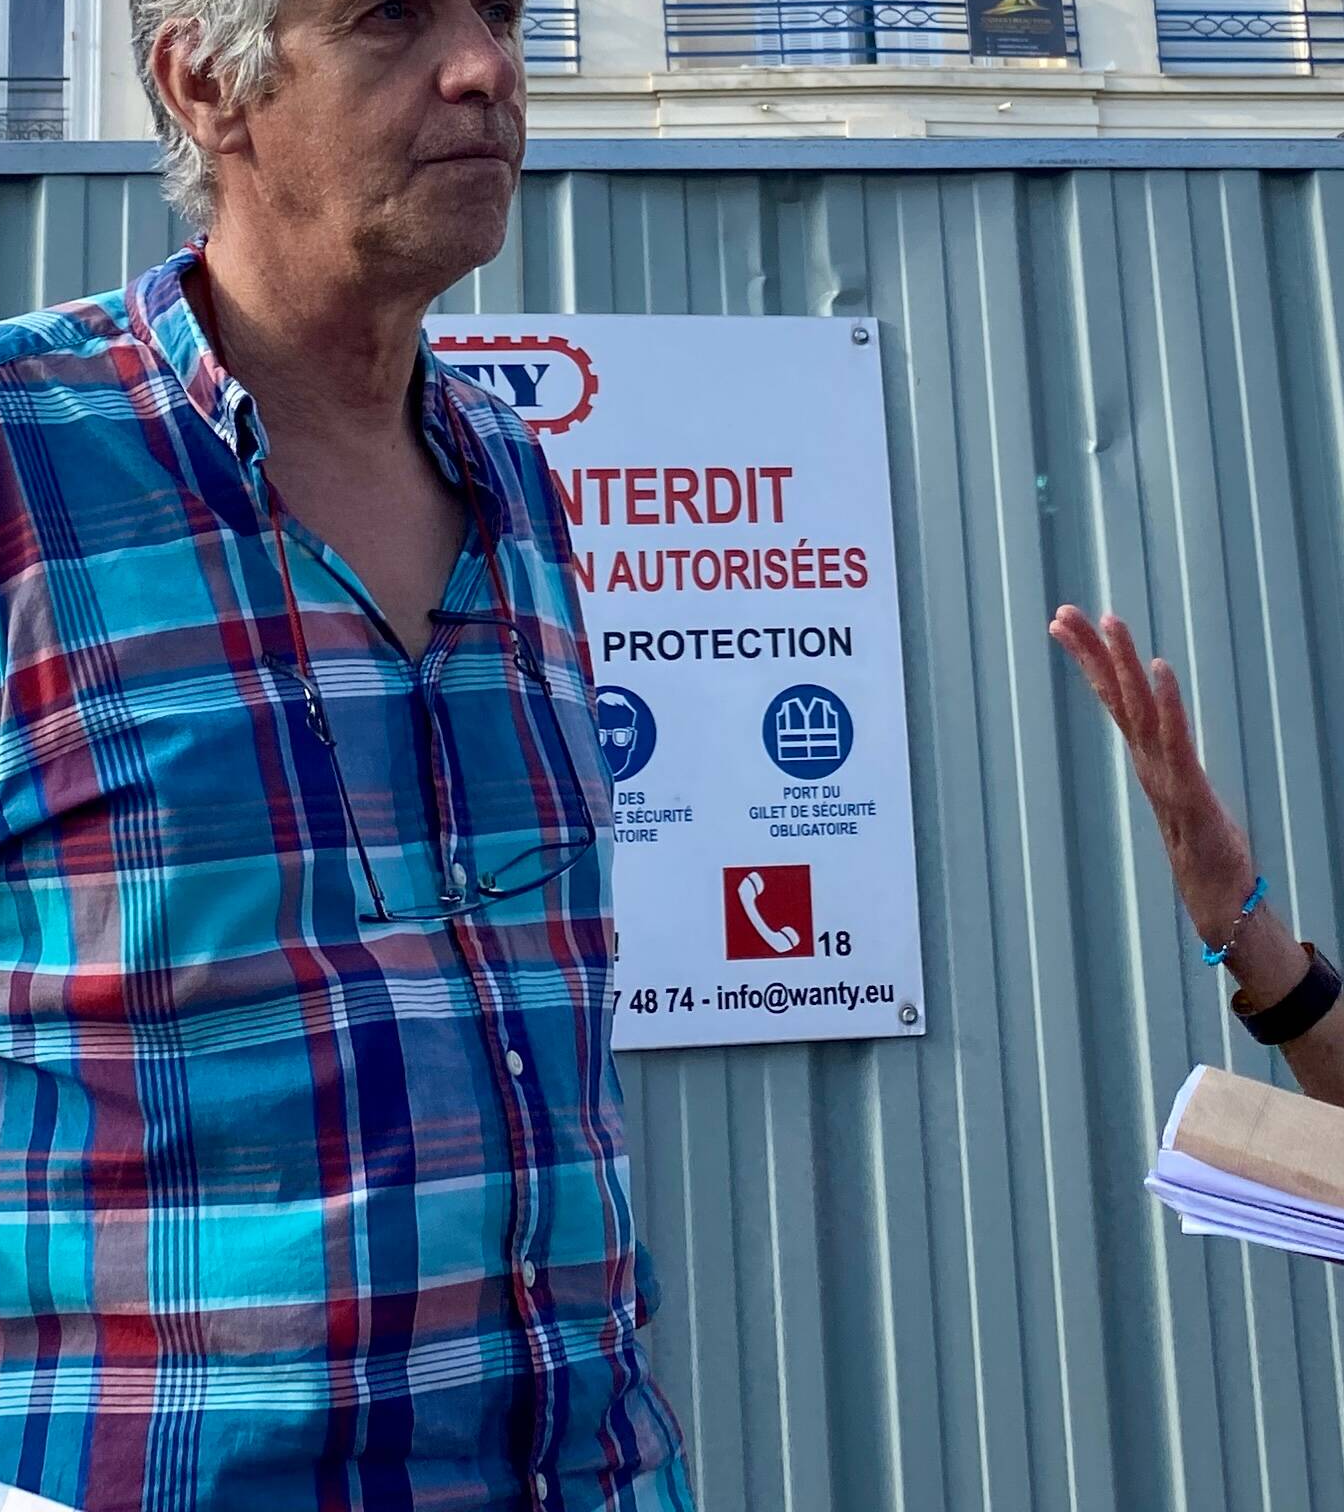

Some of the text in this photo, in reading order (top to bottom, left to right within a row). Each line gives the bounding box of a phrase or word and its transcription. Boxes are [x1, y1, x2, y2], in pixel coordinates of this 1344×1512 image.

[607, 538, 868, 593] AUTORISÉES
[603, 626, 852, 662] PROTECTION
[618, 791, 645, 806] DES
[783, 786, 840, 800] PORT DU
[626, 805, 693, 824] SÉCURITÉ
[749, 801, 876, 820] GILET DE SÉCURITÉ
[769, 822, 858, 838] OBLIGATOIRE
[818, 931, 851, 957] 18
[629, 988, 658, 1014] 48
[666, 986, 694, 1012] 74
[717, 981, 894, 1014] info@wanty.eu
